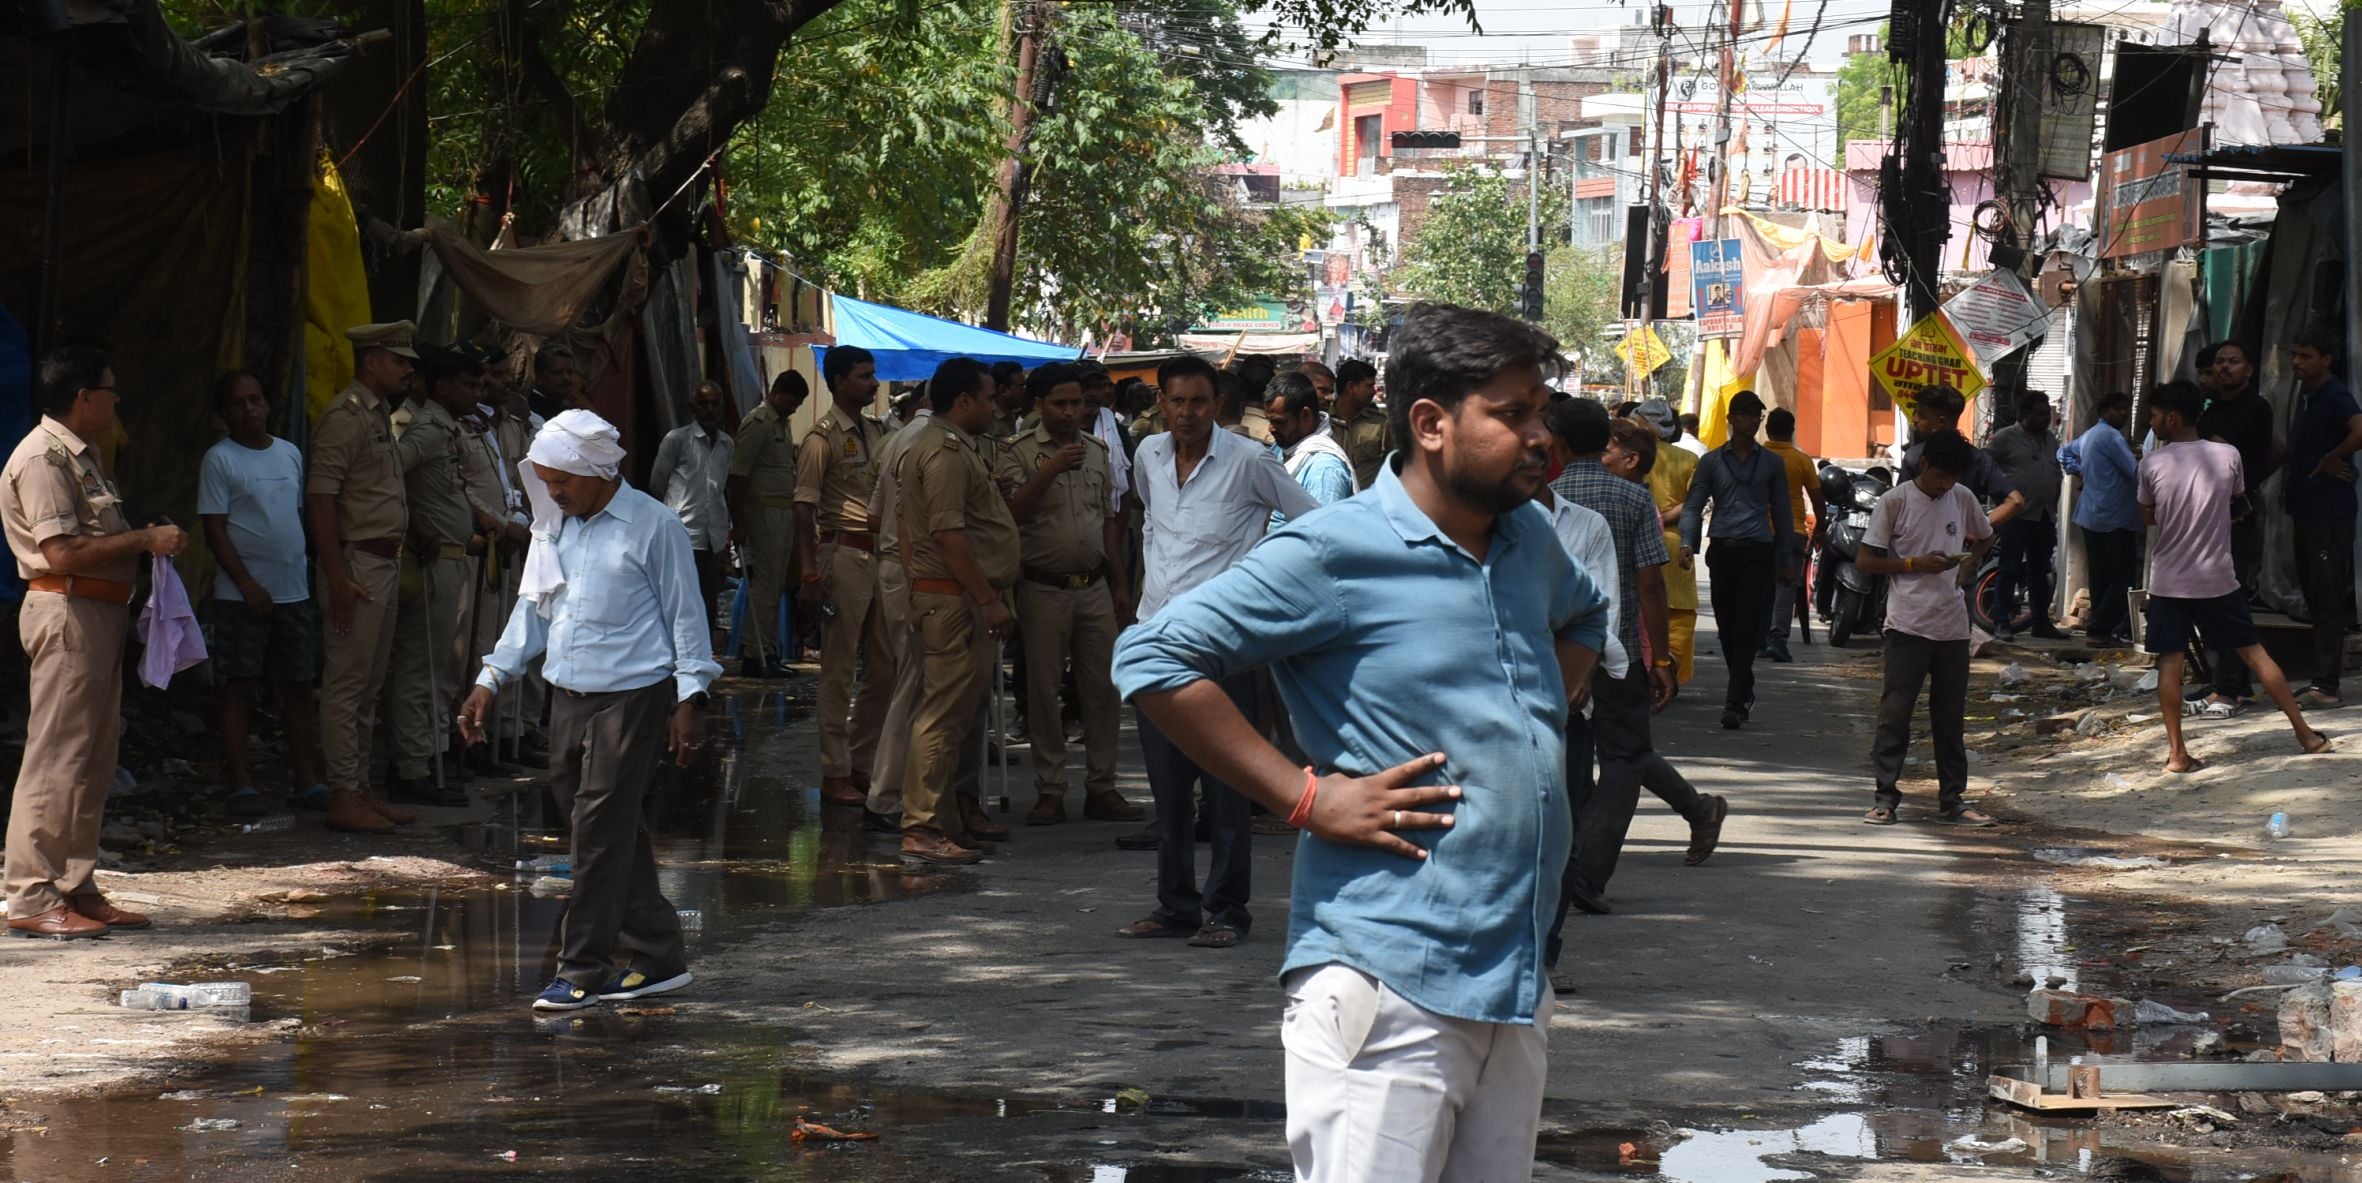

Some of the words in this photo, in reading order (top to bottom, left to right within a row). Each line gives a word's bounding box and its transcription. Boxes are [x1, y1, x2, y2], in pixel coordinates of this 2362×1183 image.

[1219, 306, 1268, 319] ealth
[1899, 349, 1937, 364] TEACHING
[1938, 357, 1962, 368] GHAR
[1886, 357, 1968, 389] UPTET
